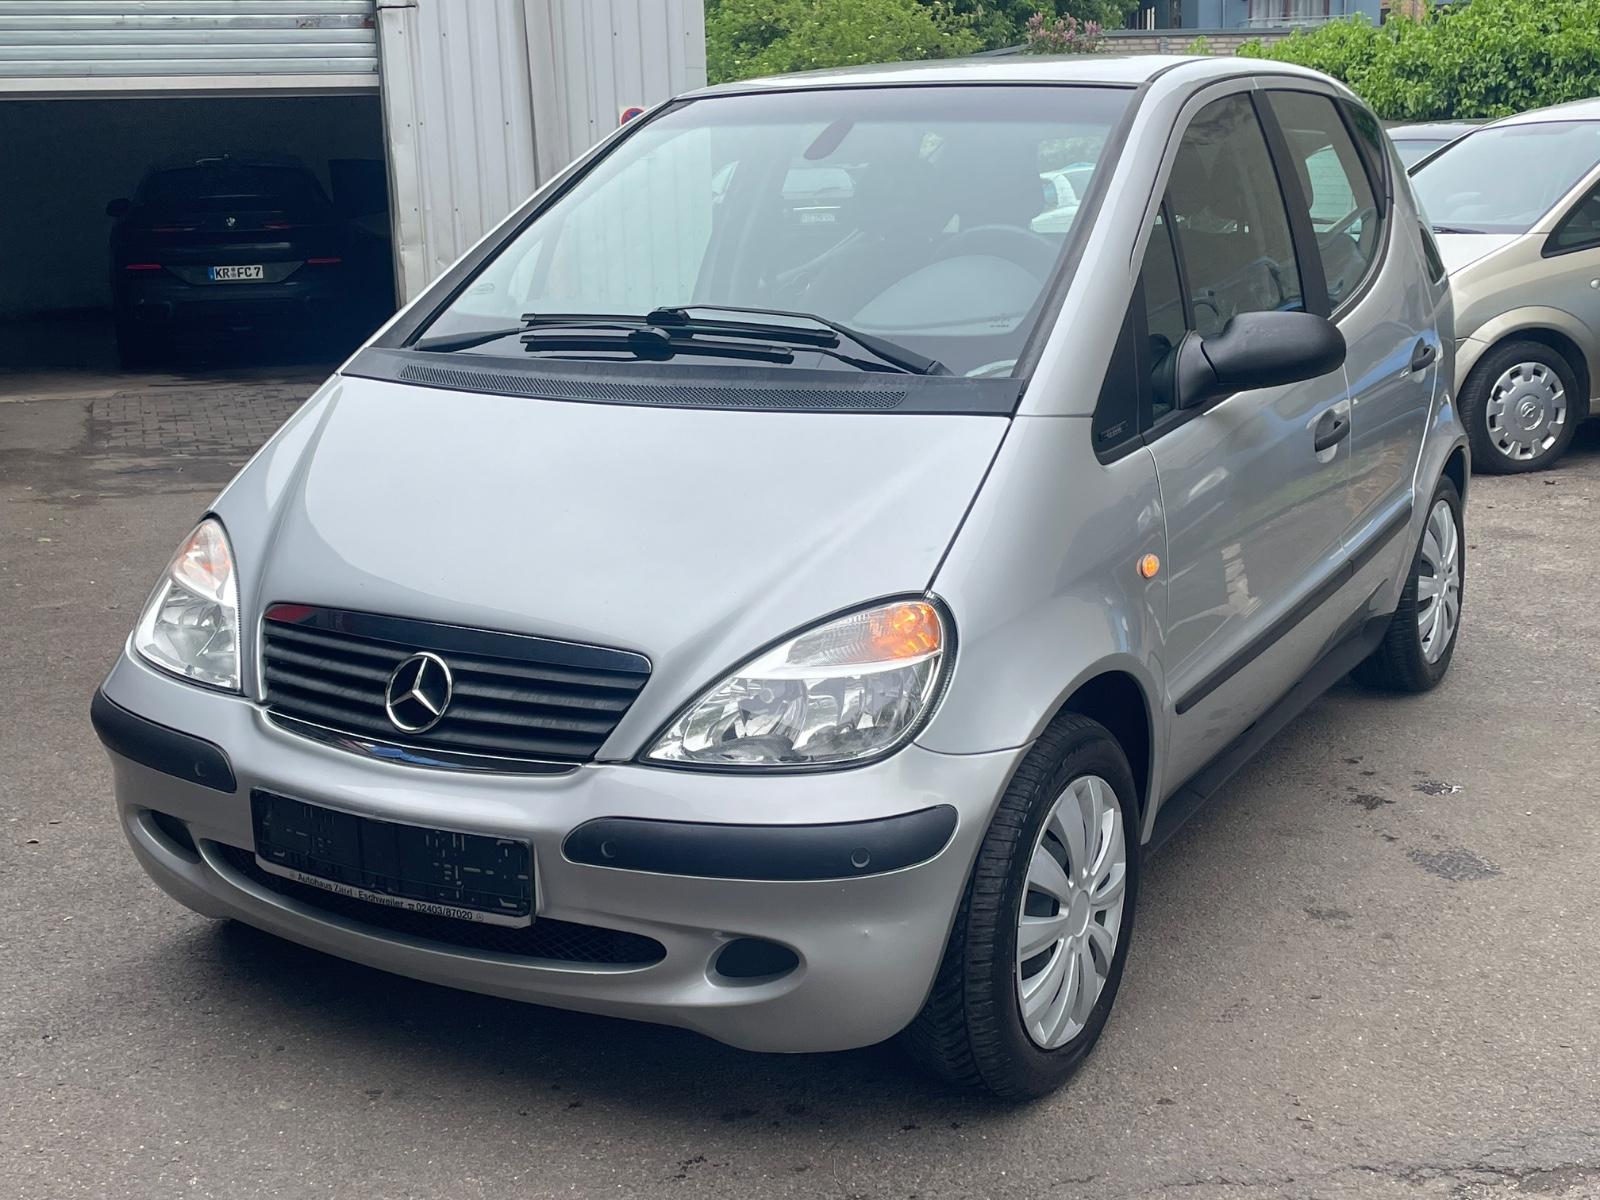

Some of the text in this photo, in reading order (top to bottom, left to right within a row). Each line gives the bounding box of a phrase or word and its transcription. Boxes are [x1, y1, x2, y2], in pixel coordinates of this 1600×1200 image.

[215, 268, 230, 279] KR
[297, 872, 333, 891] Autohaus
[358, 890, 404, 909] Eschweiler
[416, 902, 473, 920] 02403/87020
